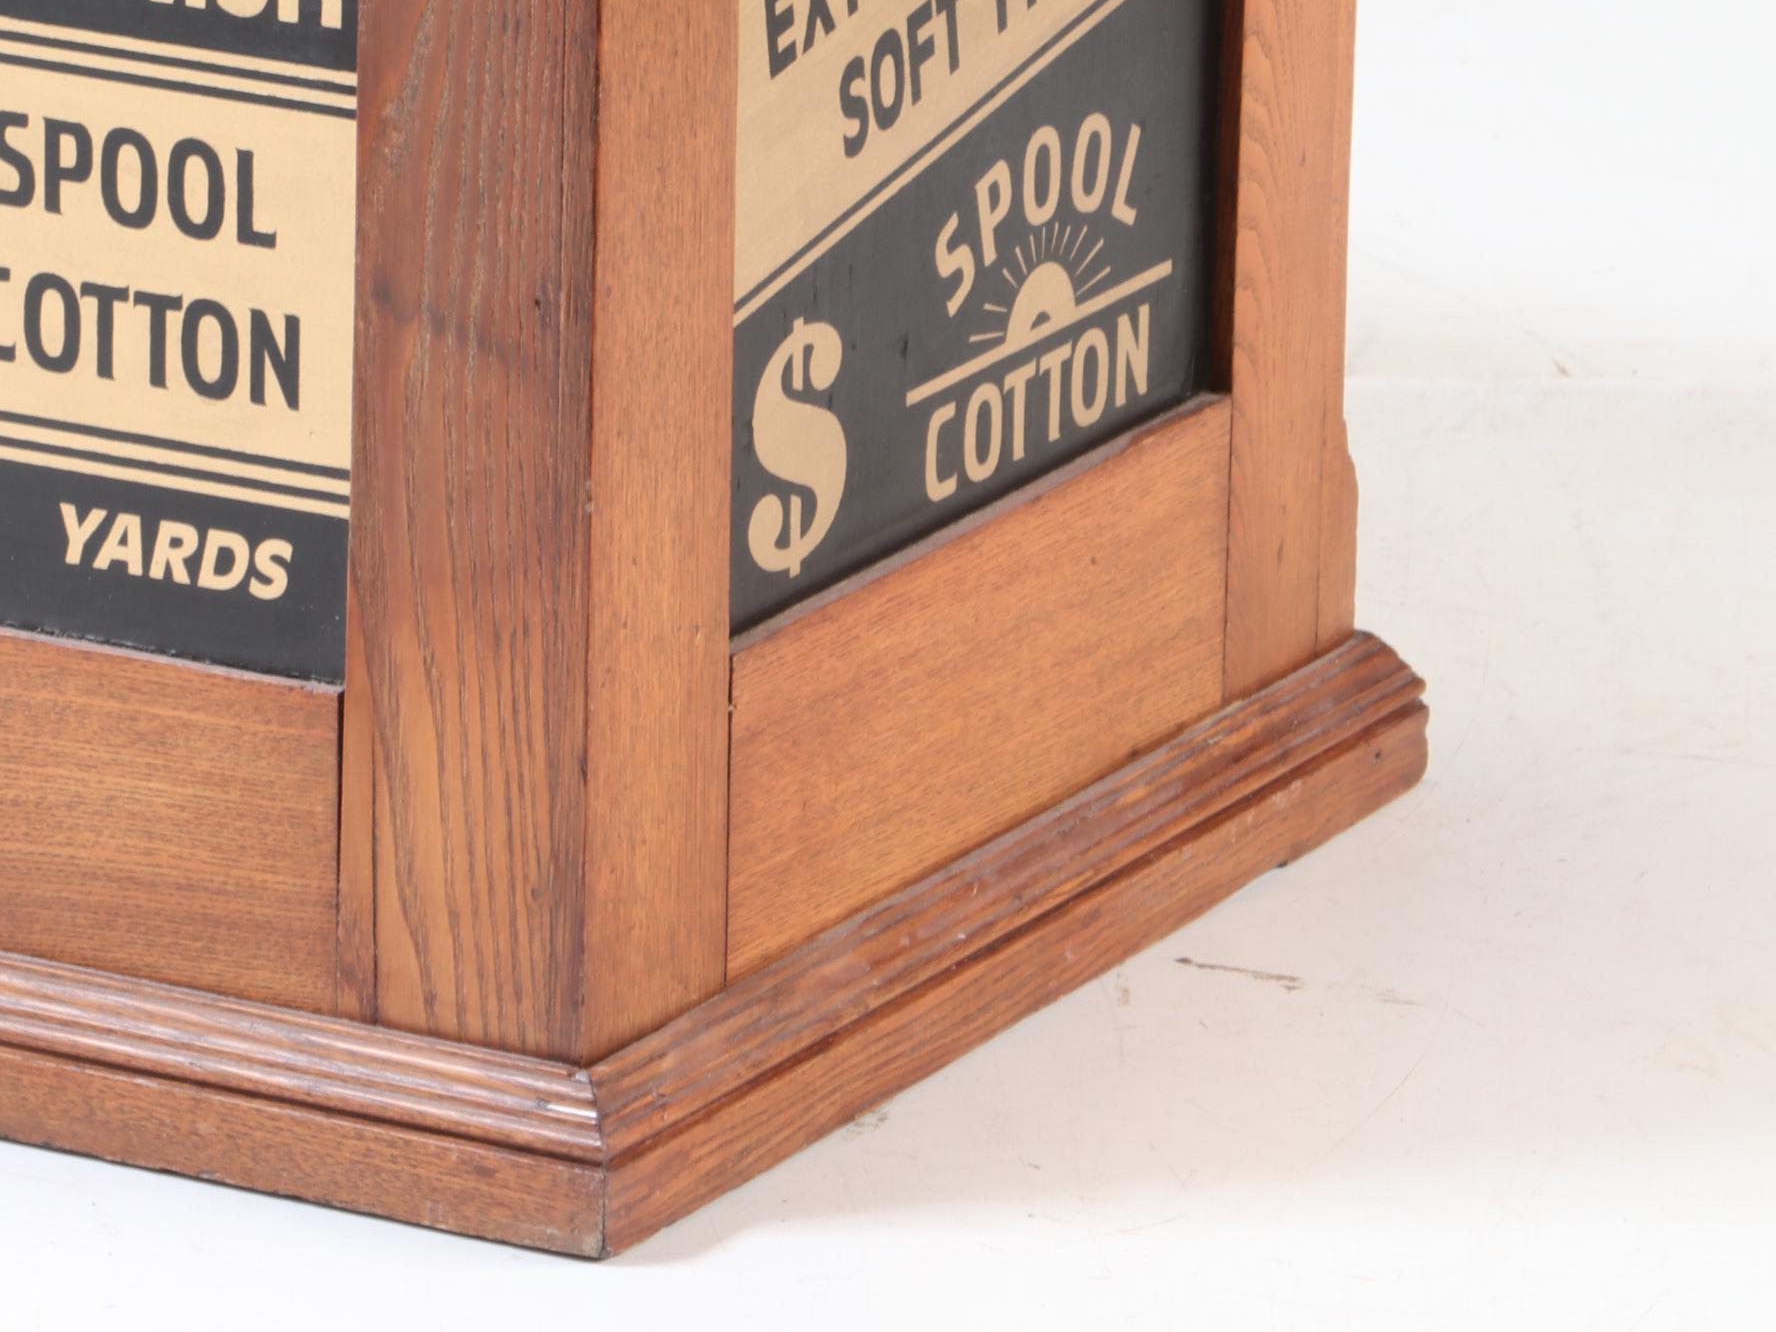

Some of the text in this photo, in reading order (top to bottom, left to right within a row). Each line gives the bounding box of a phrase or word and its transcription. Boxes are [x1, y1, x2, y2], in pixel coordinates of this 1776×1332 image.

[934, 111, 1142, 319] SPOOL
[746, 315, 848, 579] $
[924, 302, 1151, 503] COTTON
[59, 501, 294, 601] YARDS
